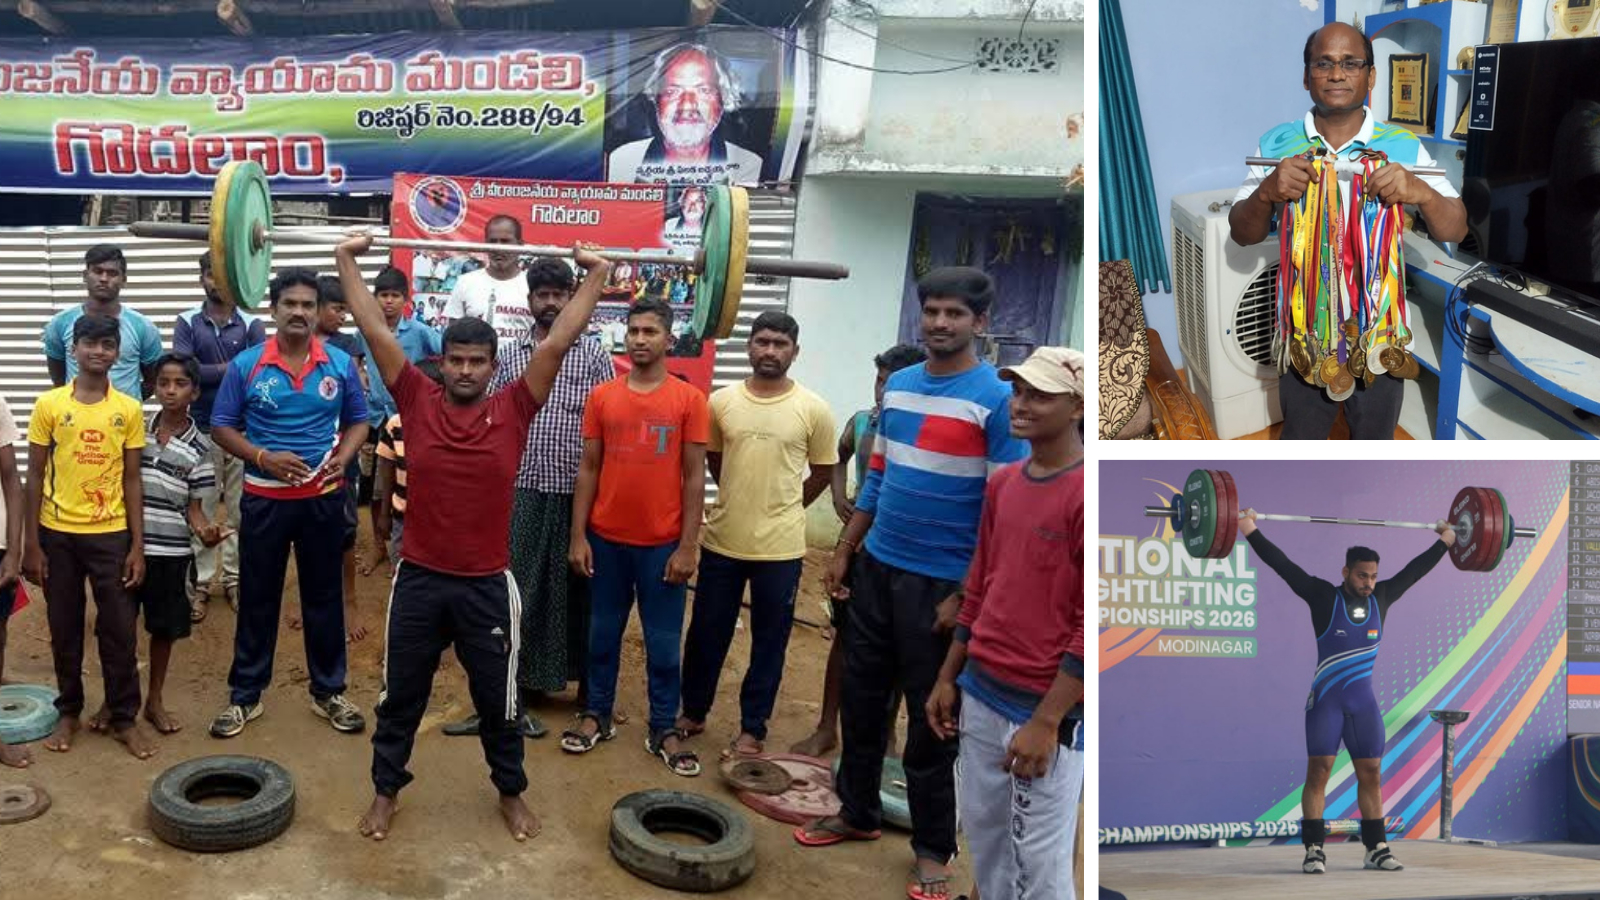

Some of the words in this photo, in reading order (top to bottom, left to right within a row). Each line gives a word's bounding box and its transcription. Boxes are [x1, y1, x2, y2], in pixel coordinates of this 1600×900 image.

[171, 55, 392, 111] వ్యాయామ
[561, 187, 618, 205] వ్యాయామ
[1572, 541, 1580, 551] 11
[1572, 554, 1580, 564] 12
[1572, 567, 1580, 577] 13
[1572, 580, 1580, 589] 14
[1208, 610, 1255, 628] 2026
[1158, 638, 1253, 655] MODINAGAR
[1568, 699, 1591, 709] SENIOR
[1099, 821, 1252, 844] CHAMPIONSHIPS
[1255, 820, 1299, 837] 2026
